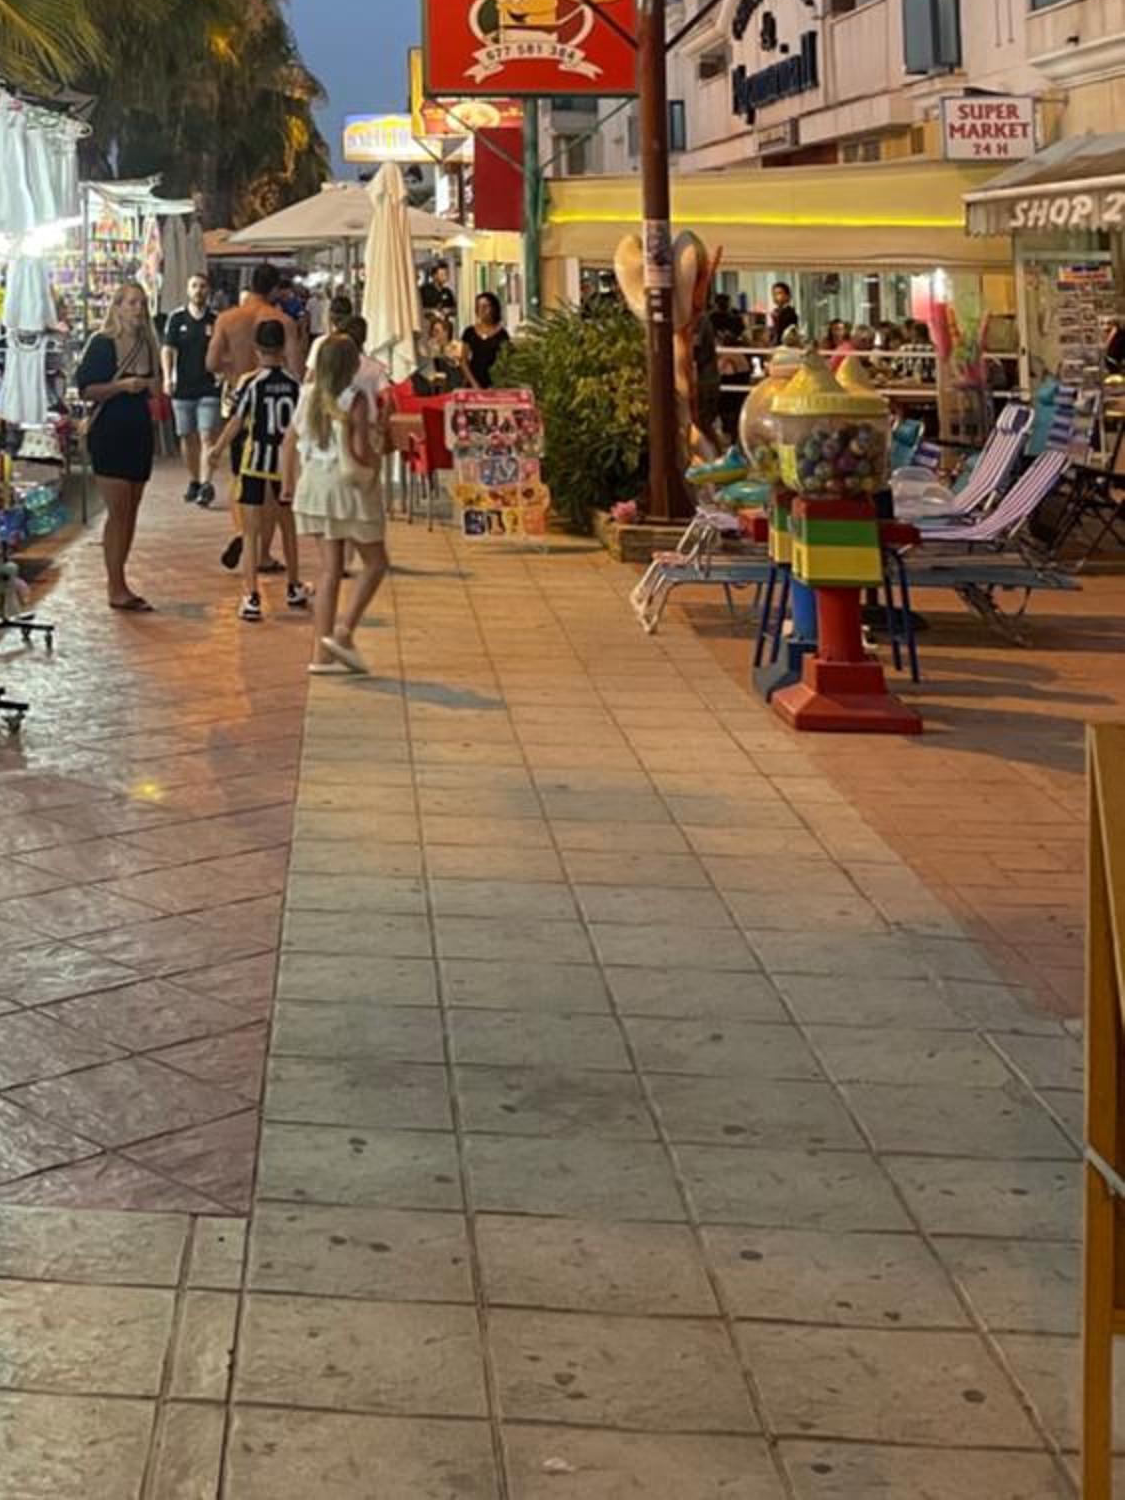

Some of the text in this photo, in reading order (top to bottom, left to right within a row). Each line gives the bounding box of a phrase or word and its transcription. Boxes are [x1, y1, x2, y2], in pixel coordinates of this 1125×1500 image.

[958, 103, 1020, 120] SUPER
[948, 122, 1030, 139] MARKET
[973, 143, 1009, 155] 24 H
[1010, 195, 1092, 228] SHOP
[263, 395, 294, 435] 10
